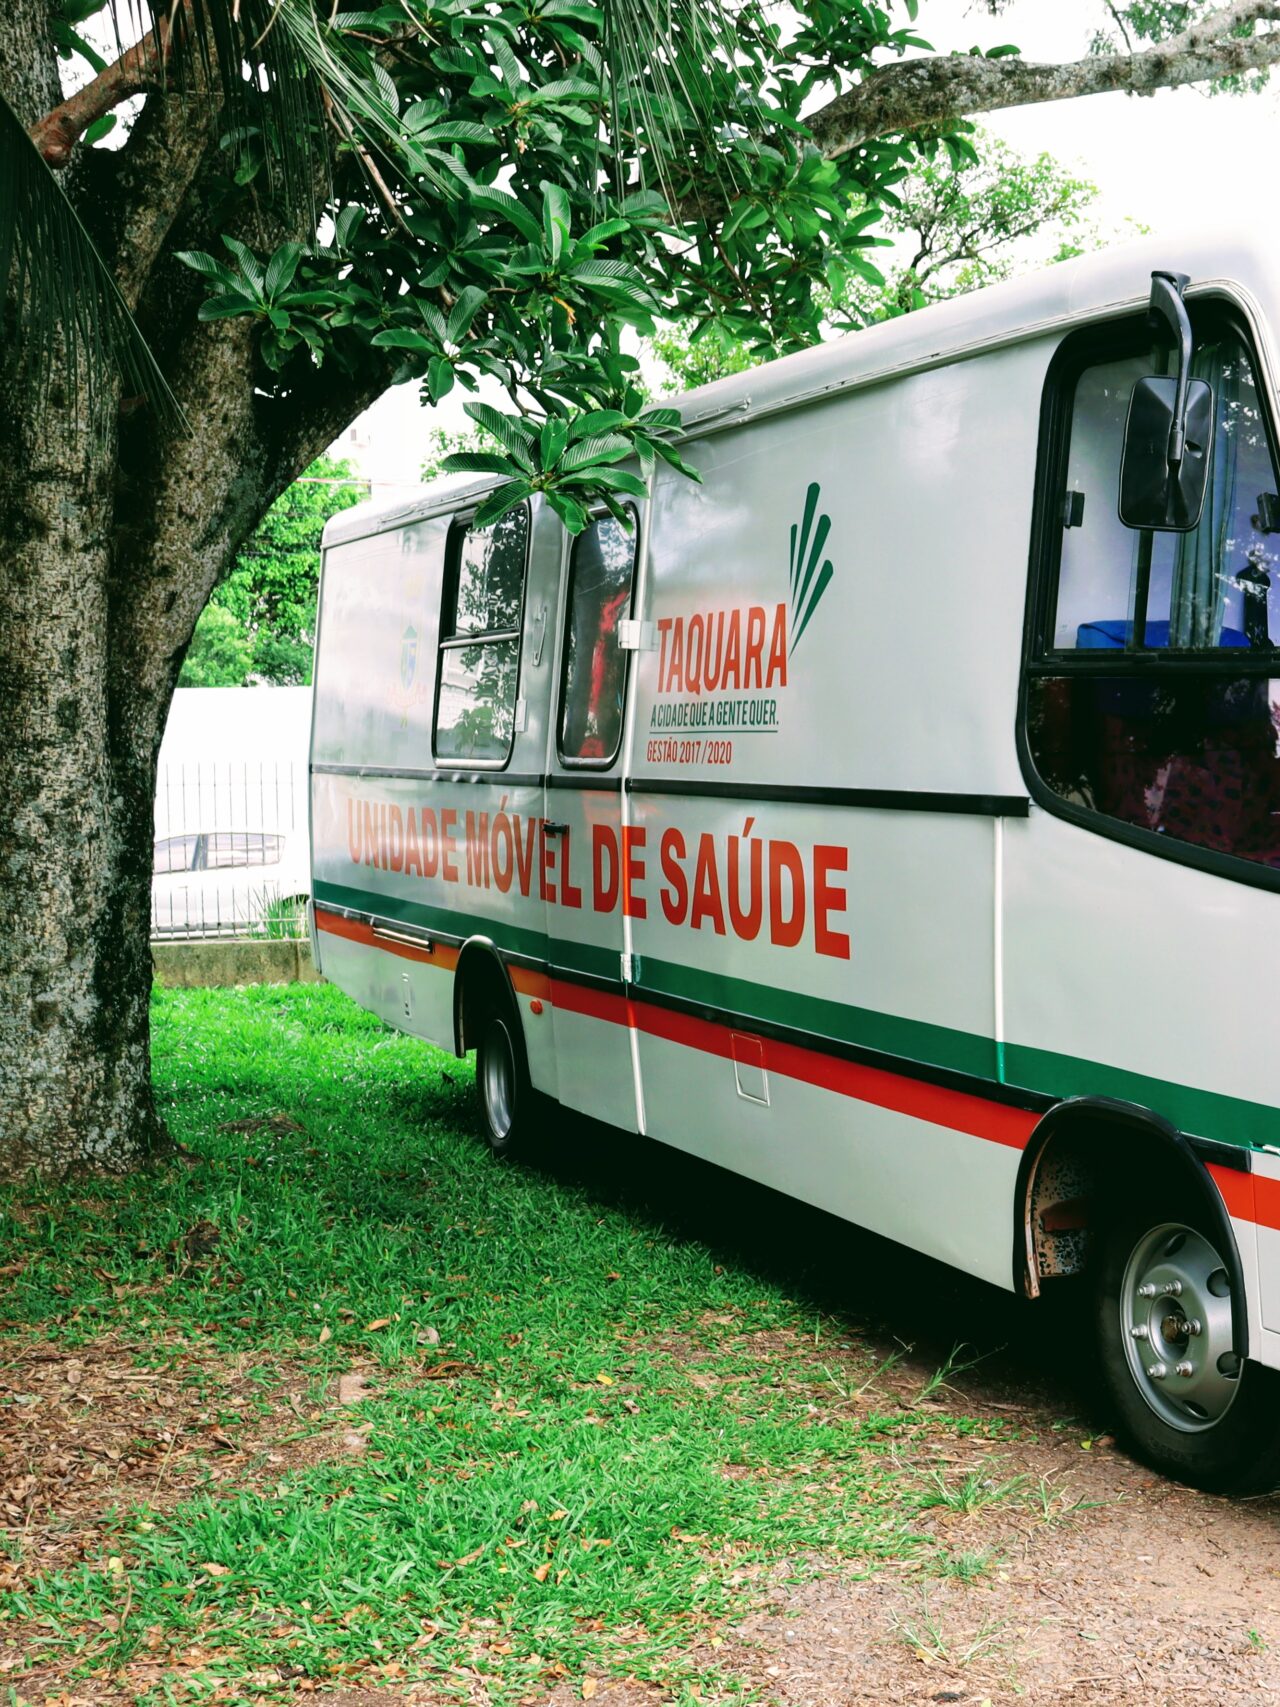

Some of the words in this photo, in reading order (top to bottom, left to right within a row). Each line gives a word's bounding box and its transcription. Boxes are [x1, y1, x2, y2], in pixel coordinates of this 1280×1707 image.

[657, 603, 787, 695] TAQUARA
[651, 704, 657, 727] A
[657, 703, 689, 727] CIDADE
[690, 702, 707, 727] QUE
[708, 701, 715, 726] A
[716, 700, 748, 726] GENTE
[749, 699, 779, 726] QUER.
[647, 737, 678, 763] GESTÃO
[348, 798, 460, 883] UNIDADE
[466, 796, 582, 909] MÓVEL
[593, 823, 648, 919] DE
[660, 816, 851, 960] SAÚDE
